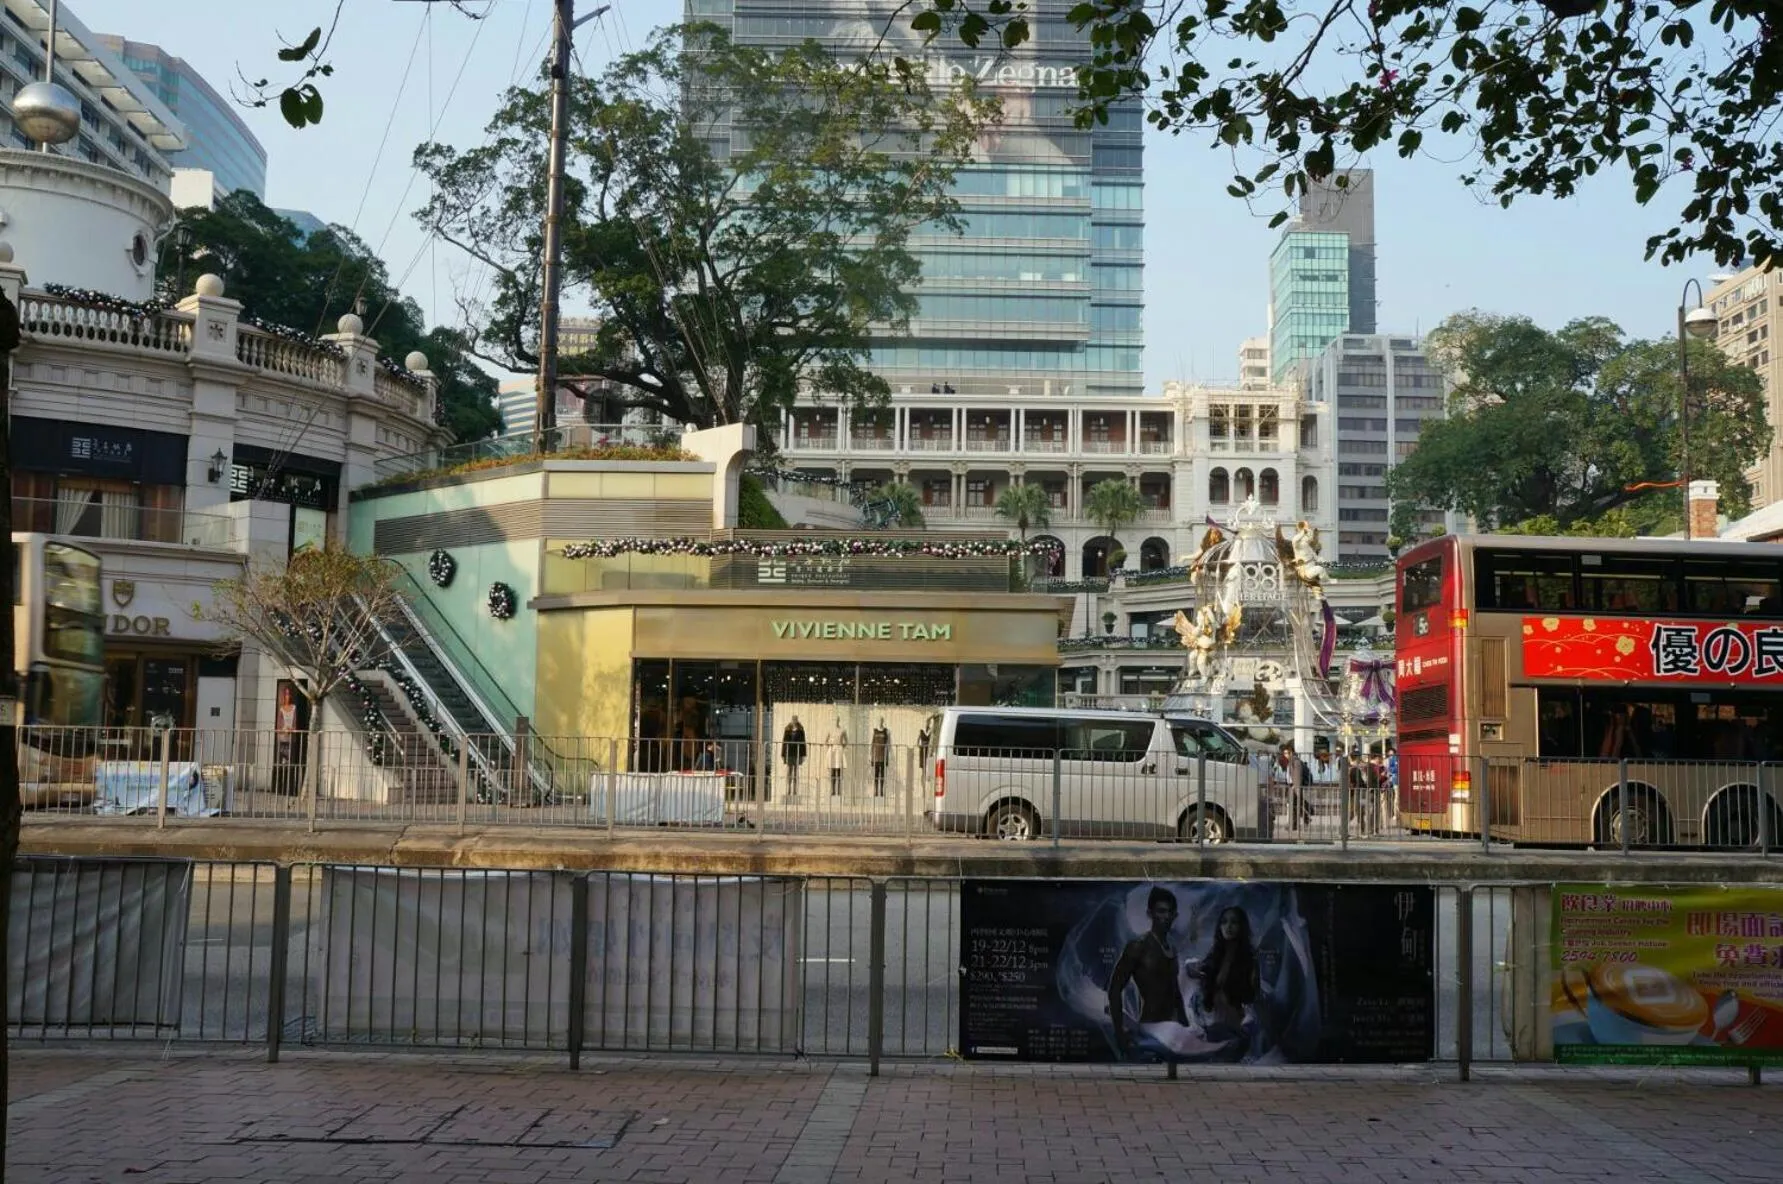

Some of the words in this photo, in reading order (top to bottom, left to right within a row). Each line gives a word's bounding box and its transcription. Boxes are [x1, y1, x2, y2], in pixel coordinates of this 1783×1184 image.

[973, 54, 1080, 92] Zegna
[104, 613, 171, 636] DOR
[771, 619, 892, 639] VIVIENNE
[898, 622, 952, 641] TAM
[1649, 623, 1783, 678] 優の良
